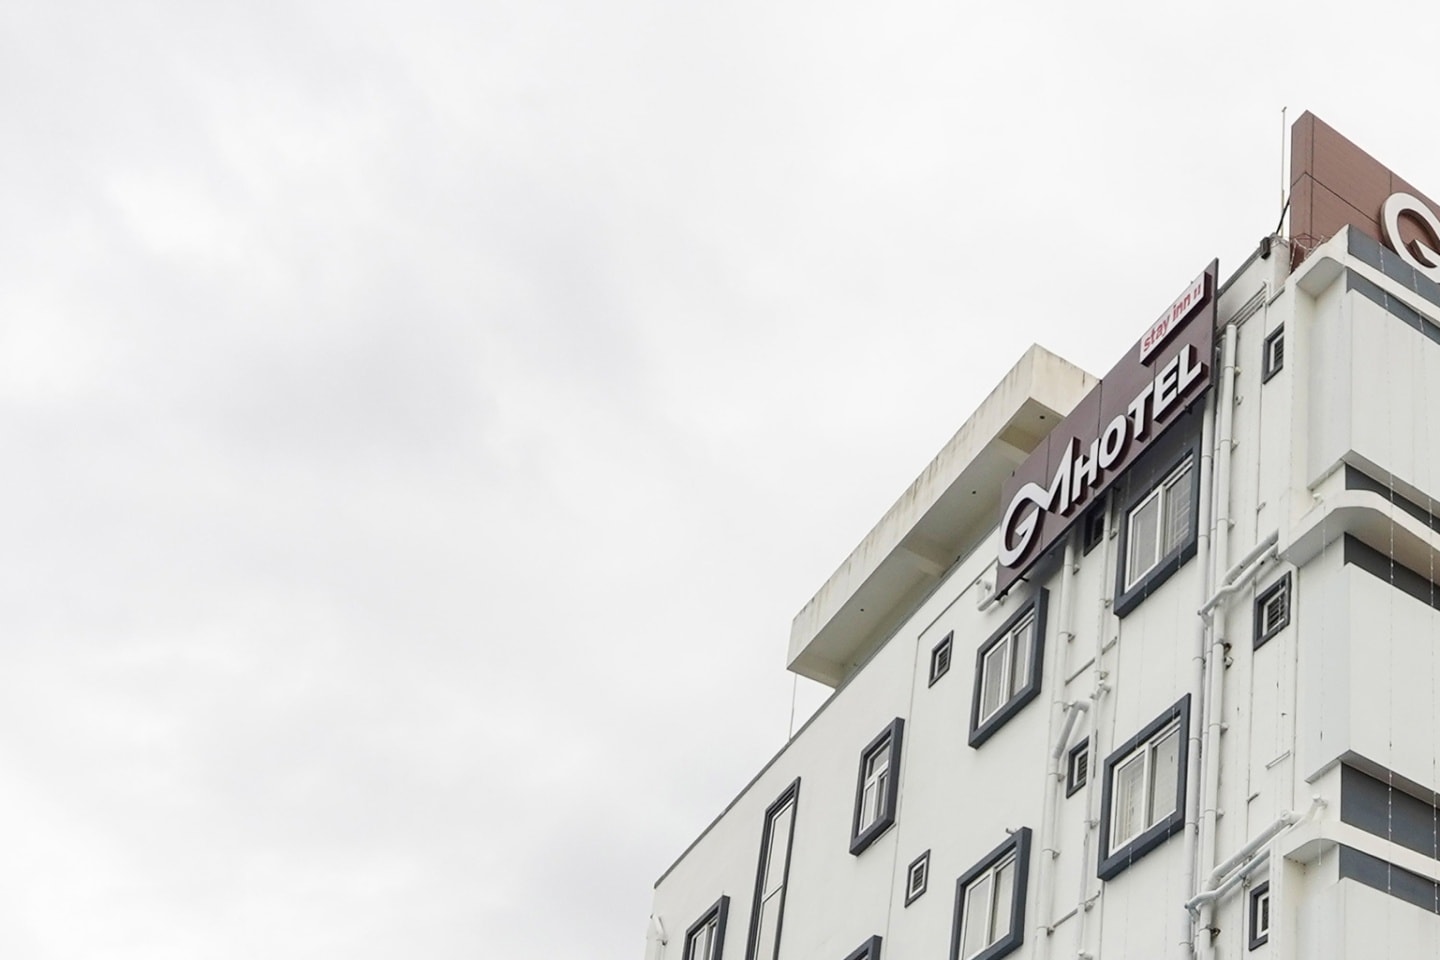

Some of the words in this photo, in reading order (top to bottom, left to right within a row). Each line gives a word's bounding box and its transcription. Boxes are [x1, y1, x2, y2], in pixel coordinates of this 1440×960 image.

[1143, 315, 1171, 352] stay
[1172, 293, 1191, 322] inn
[1072, 344, 1203, 502] HOTEL
